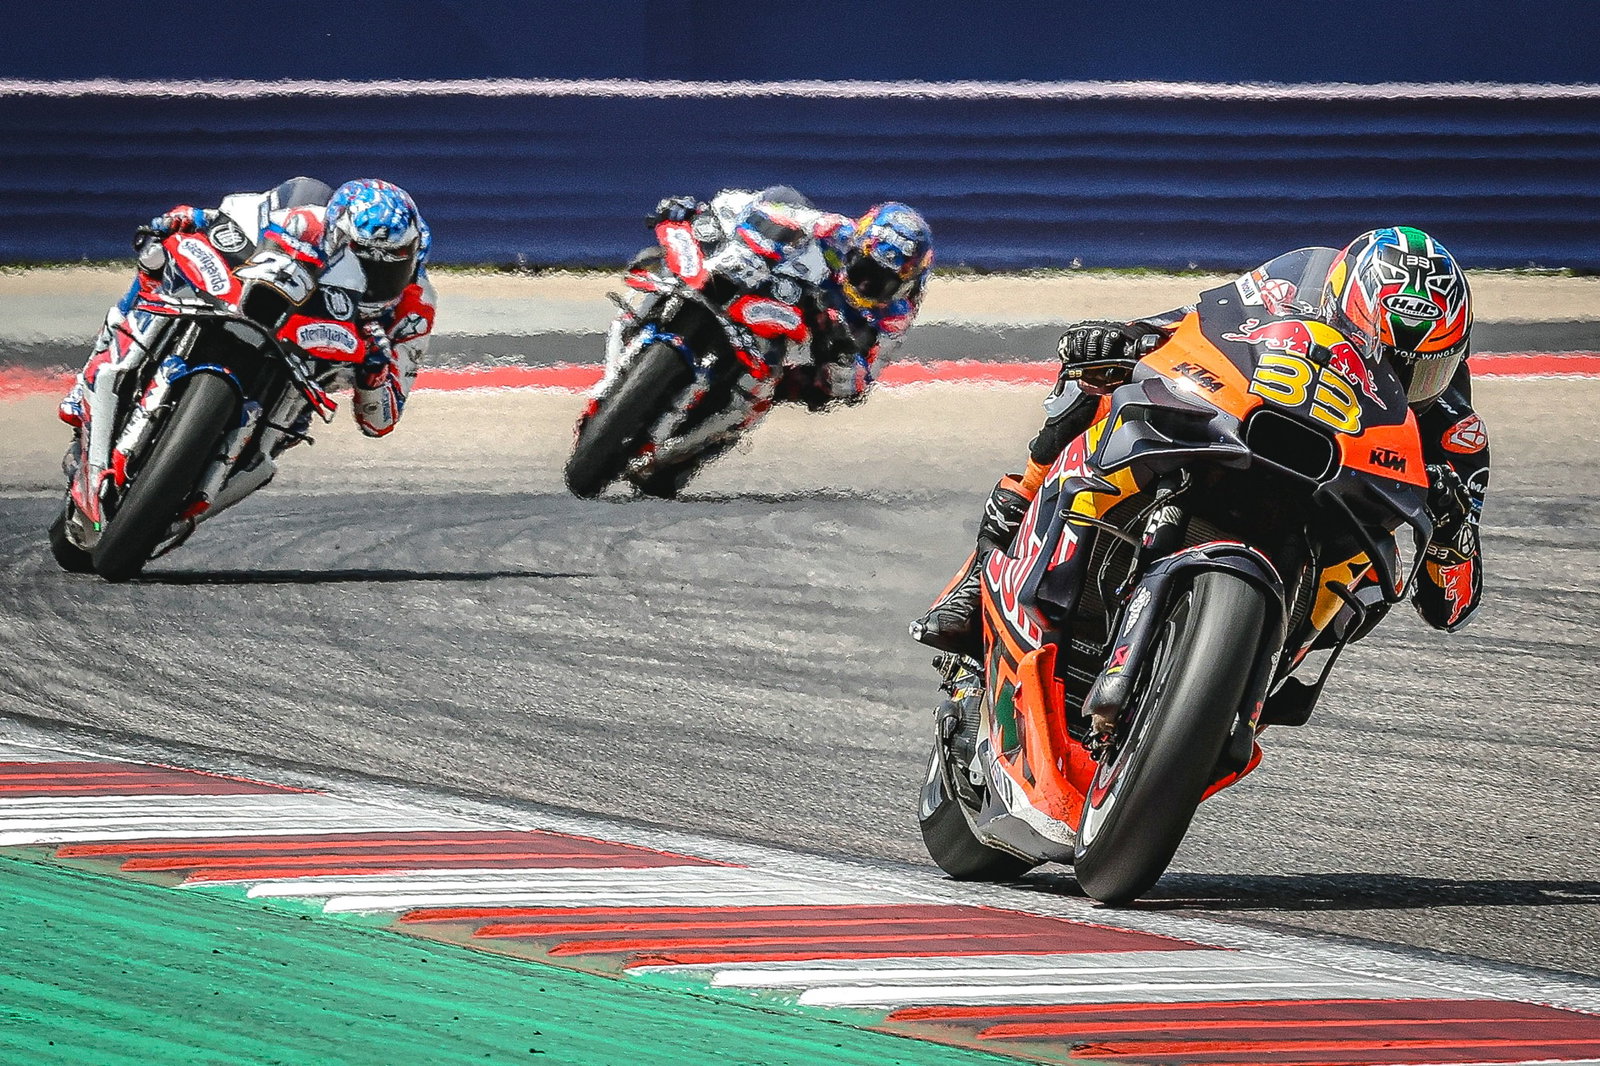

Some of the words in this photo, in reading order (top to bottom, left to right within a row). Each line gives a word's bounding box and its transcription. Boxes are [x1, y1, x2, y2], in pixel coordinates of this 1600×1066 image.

[1407, 255, 1431, 269] 33
[1390, 298, 1437, 316] HJC
[1394, 348, 1416, 359] YOU
[1422, 347, 1455, 361] WINGS
[1171, 361, 1225, 392] KTM
[1249, 352, 1363, 435] 33
[1369, 447, 1407, 473] KTM
